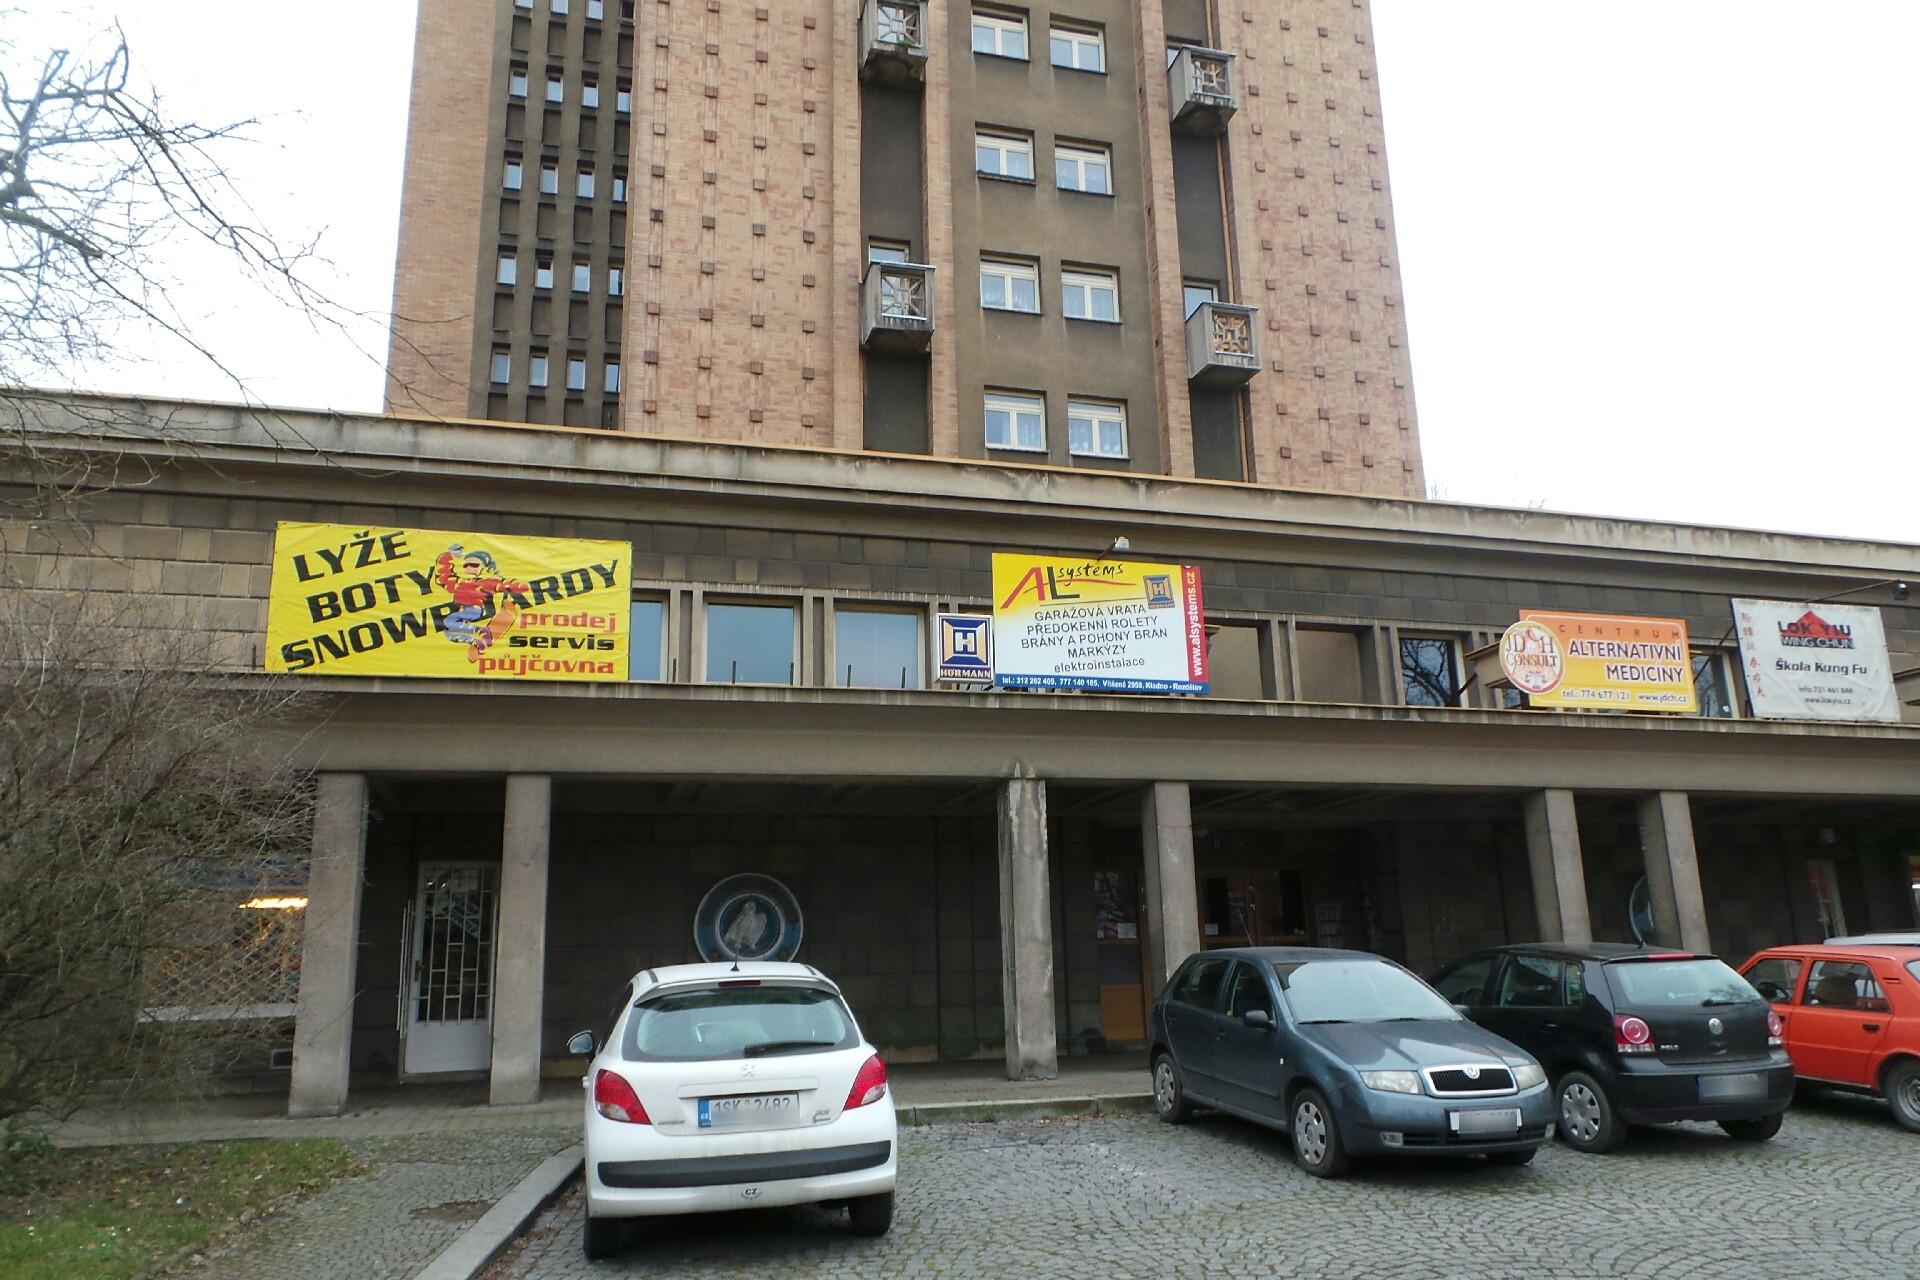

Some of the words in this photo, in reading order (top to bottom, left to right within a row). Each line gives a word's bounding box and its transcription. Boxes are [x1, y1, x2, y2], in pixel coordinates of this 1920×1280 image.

[292, 530, 412, 582] LYŽE
[305, 565, 436, 624] BOTY
[520, 611, 616, 633] prodej
[1034, 607, 1104, 621] GARÁŽOVÁ
[1107, 604, 1146, 616] VRATA
[1027, 617, 1108, 635] PŘEDOKENNÍ
[1111, 616, 1158, 629] ROLETY
[1187, 571, 1203, 676] www.alsystems.cz
[1559, 624, 1680, 639] CENTRUM
[1777, 620, 1809, 635] LOK
[508, 634, 615, 651] servis
[955, 632, 975, 652] H
[1021, 635, 1064, 649] BRÁNY
[1067, 636, 1076, 645] A
[1080, 631, 1130, 644] POHONY
[1134, 628, 1168, 640] BRAN
[1781, 636, 1814, 646] WING
[1817, 637, 1854, 649] CHUN
[1067, 643, 1127, 658] MARKÝZY
[1569, 640, 1681, 661] ALTERNATIVNÍ
[477, 653, 614, 676] půjčovna
[1054, 658, 1145, 673] elektroinstalace
[1776, 658, 1811, 671] Škola
[1815, 662, 1848, 675] Kung
[1853, 664, 1867, 674] Fu
